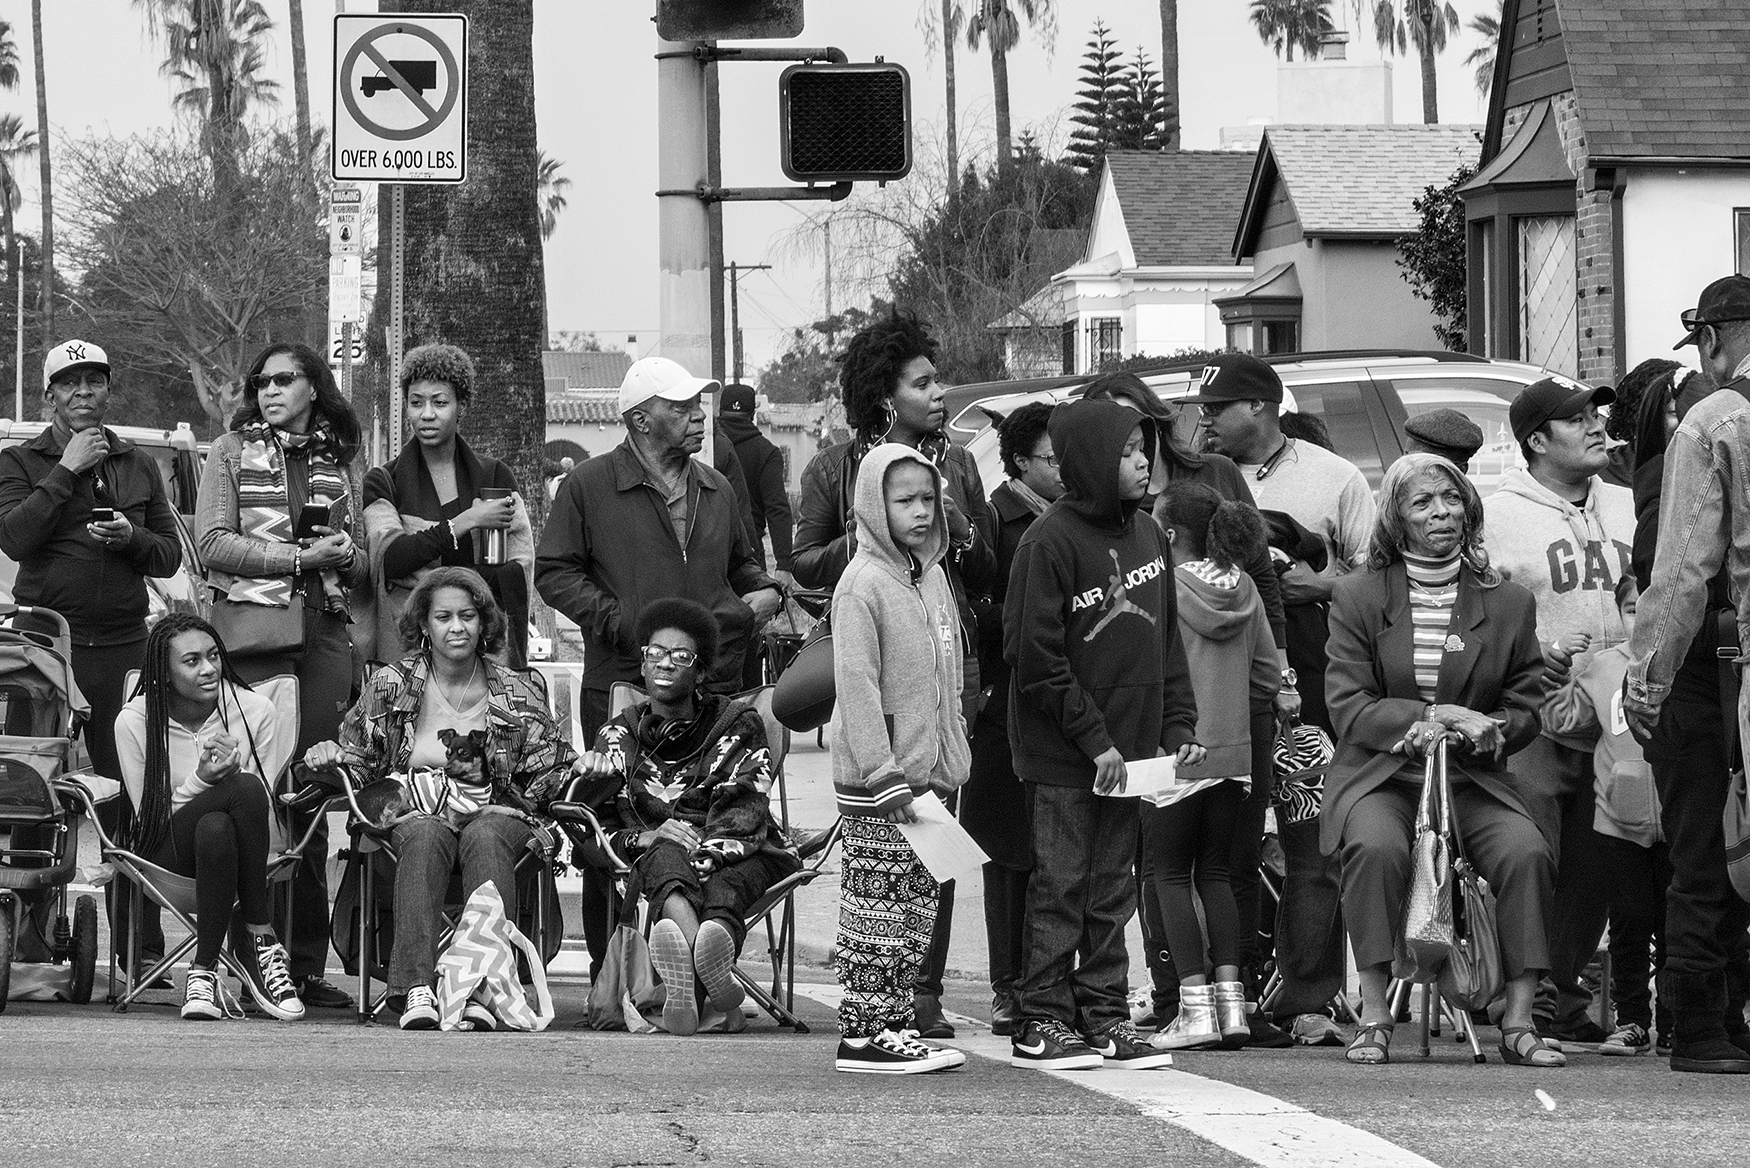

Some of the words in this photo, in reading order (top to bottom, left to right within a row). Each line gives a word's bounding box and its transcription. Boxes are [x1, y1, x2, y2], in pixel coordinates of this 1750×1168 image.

[341, 149, 377, 168] OVER
[382, 149, 423, 169] 6,000
[427, 150, 458, 169] LBS.
[337, 214, 355, 223] WATCH
[332, 258, 343, 273] NO
[332, 275, 359, 290] PARKING
[66, 343, 86, 361] NY
[333, 339, 362, 359] 25
[1124, 555, 1166, 589] JORDN
[1072, 587, 1104, 612] AIR
